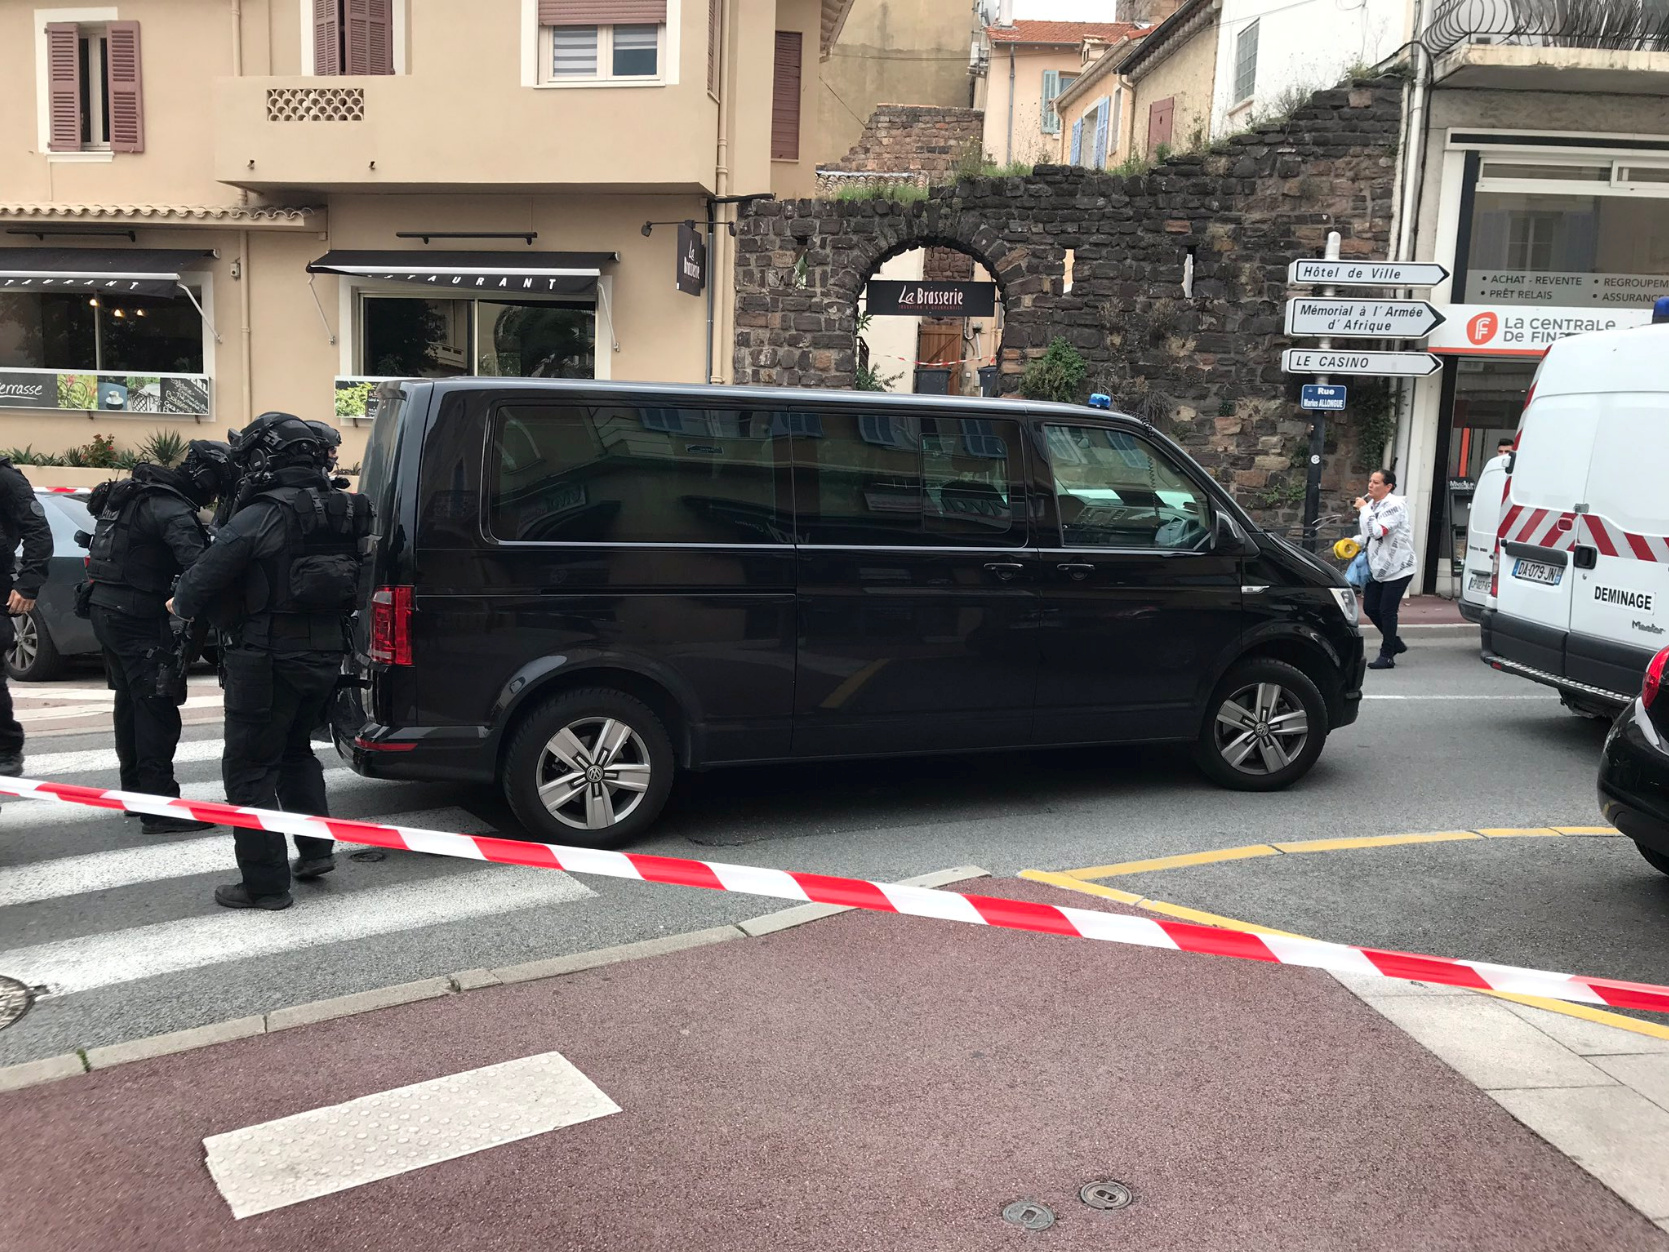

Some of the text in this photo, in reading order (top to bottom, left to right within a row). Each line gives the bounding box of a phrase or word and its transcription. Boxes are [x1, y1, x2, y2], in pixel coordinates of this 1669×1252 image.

[1303, 266, 1401, 280] Hôtel de Ville
[1490, 274, 1526, 284] ACHAT
[1535, 276, 1583, 286] REVENTE
[898, 284, 964, 305] La Brasserie
[1489, 287, 1553, 300] PRÊT RELAIS
[1602, 292, 1667, 303] ASSURANC
[1299, 304, 1353, 316] Mémorial
[1359, 306, 1366, 317] à
[1296, 355, 1369, 369] LE CASINO
[0, 382, 43, 396] errasse
[1317, 387, 1335, 396] Rue
[1517, 562, 1557, 582] DA-079-JN
[1594, 585, 1652, 611] DEMINAGE
